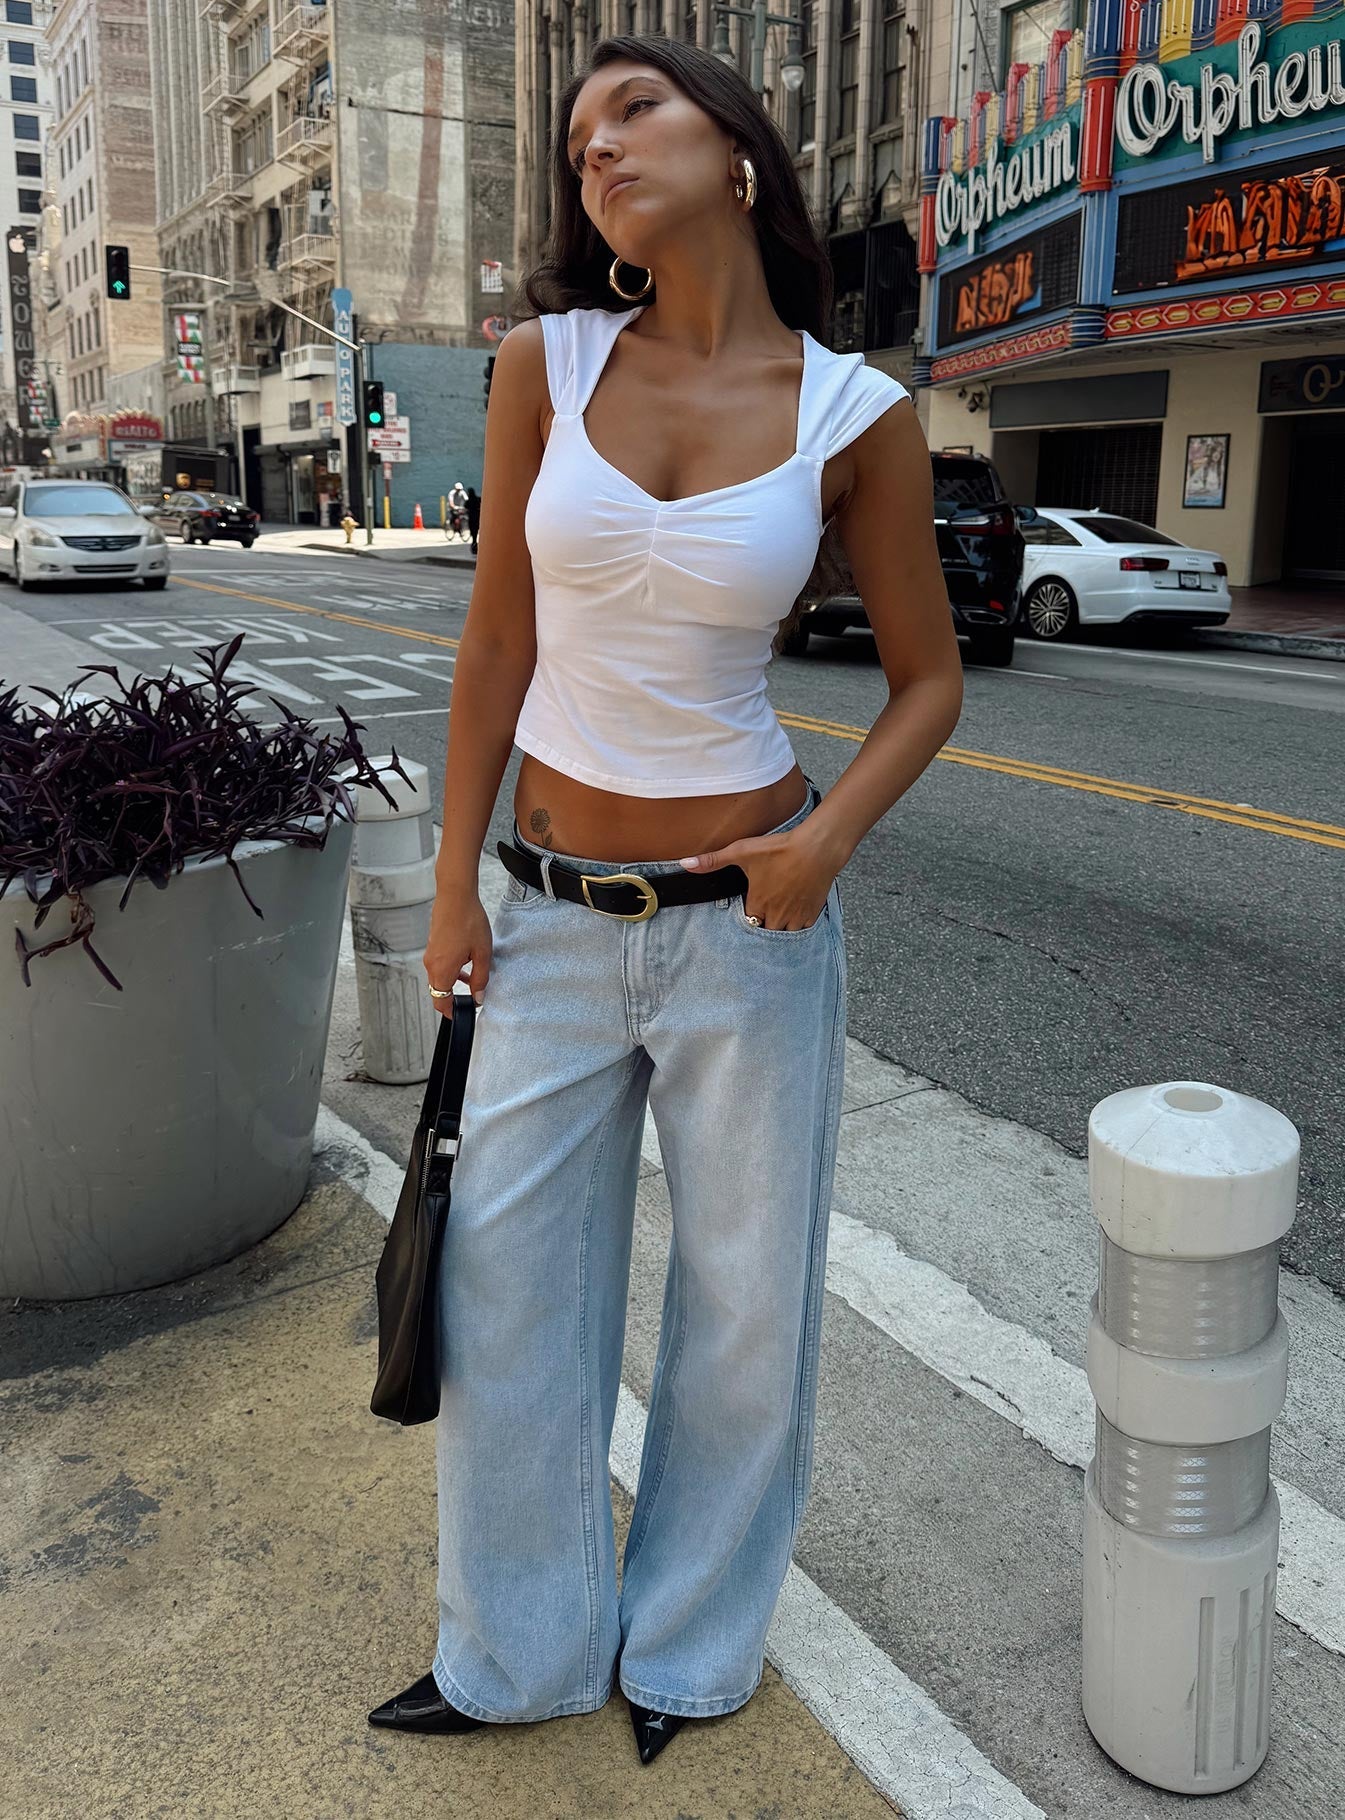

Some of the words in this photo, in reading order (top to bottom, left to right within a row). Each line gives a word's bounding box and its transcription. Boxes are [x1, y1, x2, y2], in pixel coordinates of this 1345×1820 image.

[935, 122, 1074, 255] Orpheum
[340, 367, 353, 418] PARK
[88, 616, 343, 650] KEEP
